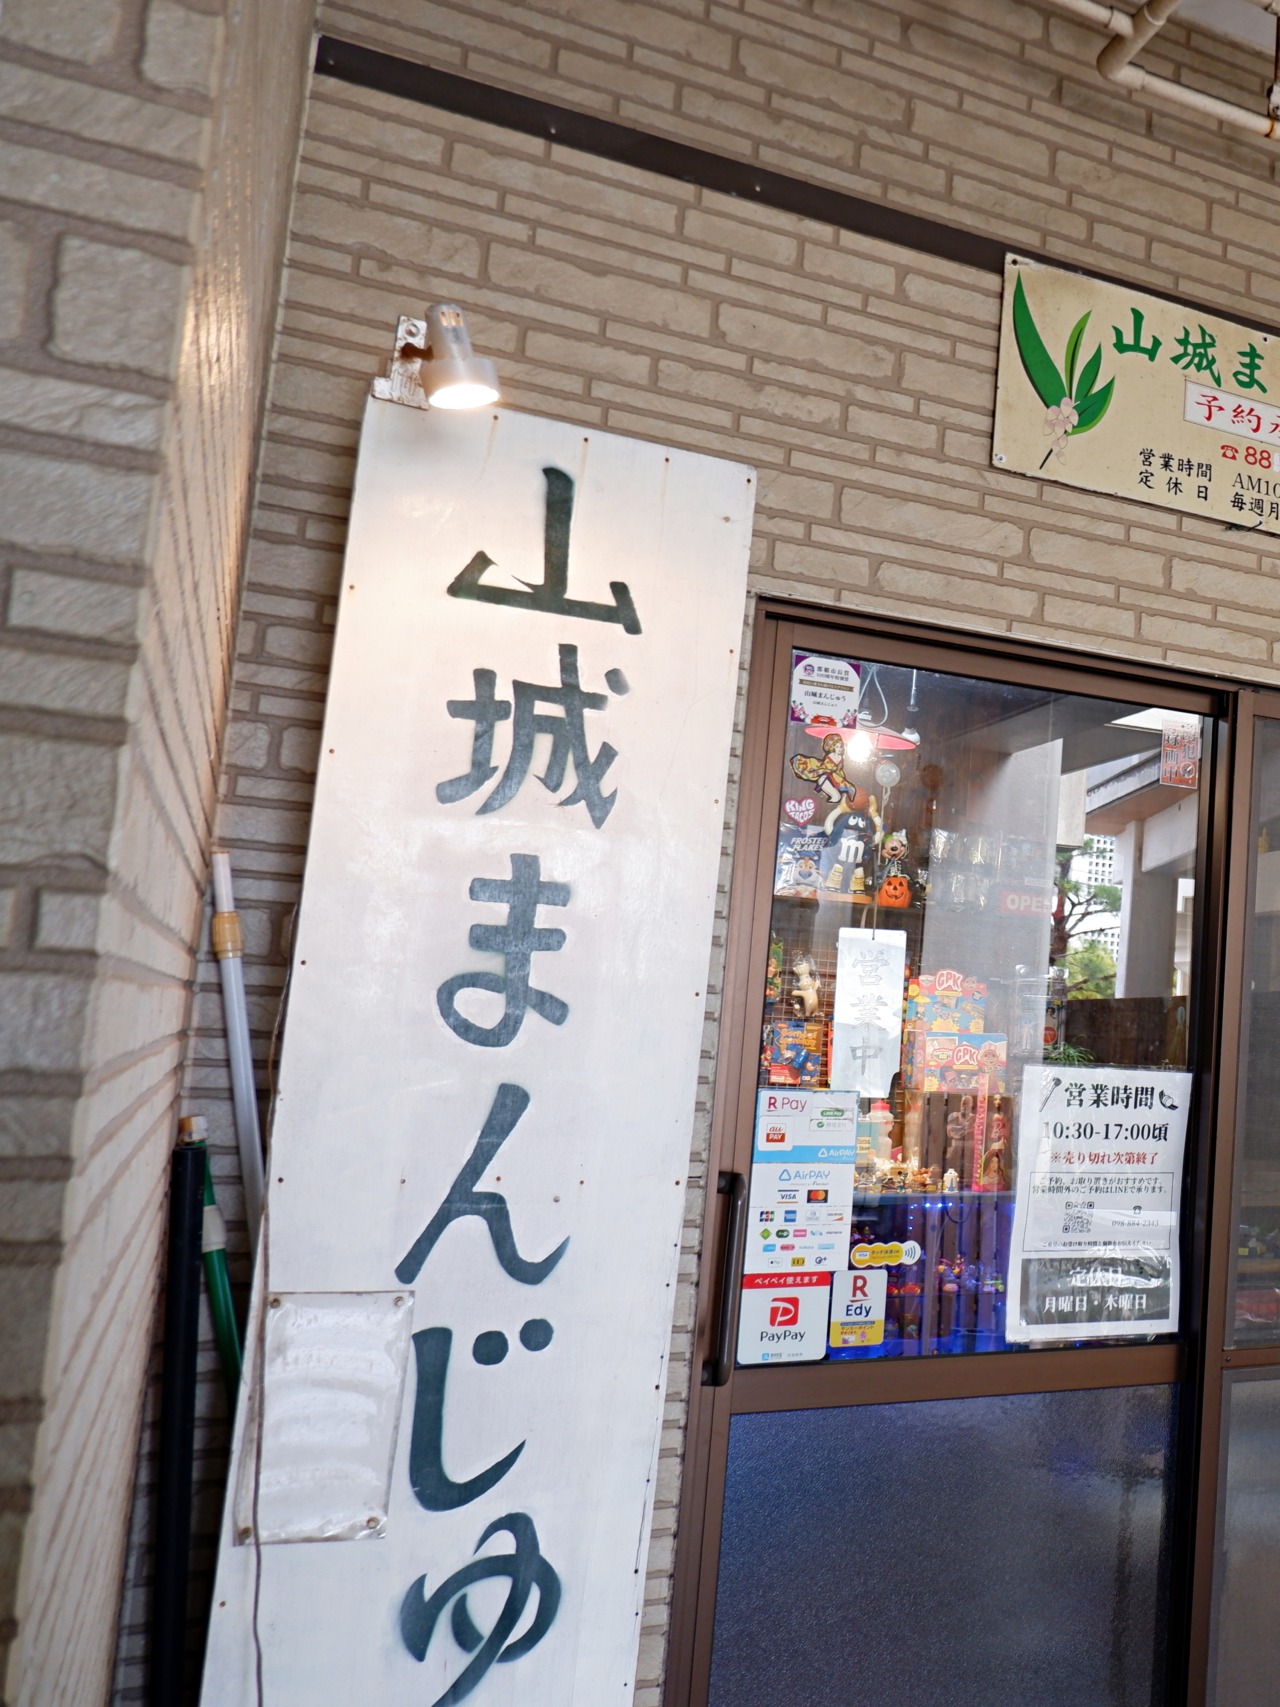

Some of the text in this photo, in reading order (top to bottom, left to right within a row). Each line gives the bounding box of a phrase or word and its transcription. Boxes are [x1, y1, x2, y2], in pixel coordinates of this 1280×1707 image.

[1139, 448, 1212, 482] 営業時間
[1138, 469, 1209, 502] 定休日
[785, 799, 815, 813] KING
[850, 949, 890, 1077] 営業中
[781, 1097, 807, 1112] Pay
[1064, 1082, 1155, 1110] 営業時間
[1041, 1121, 1169, 1142] 10:30-17:00頃
[793, 1170, 830, 1180] AirPAY
[755, 1275, 818, 1285] ペイペイ使えます
[846, 1303, 872, 1318] Edy
[1044, 1293, 1147, 1313] 月曜日・木曜日
[760, 1330, 806, 1343] PayPay
